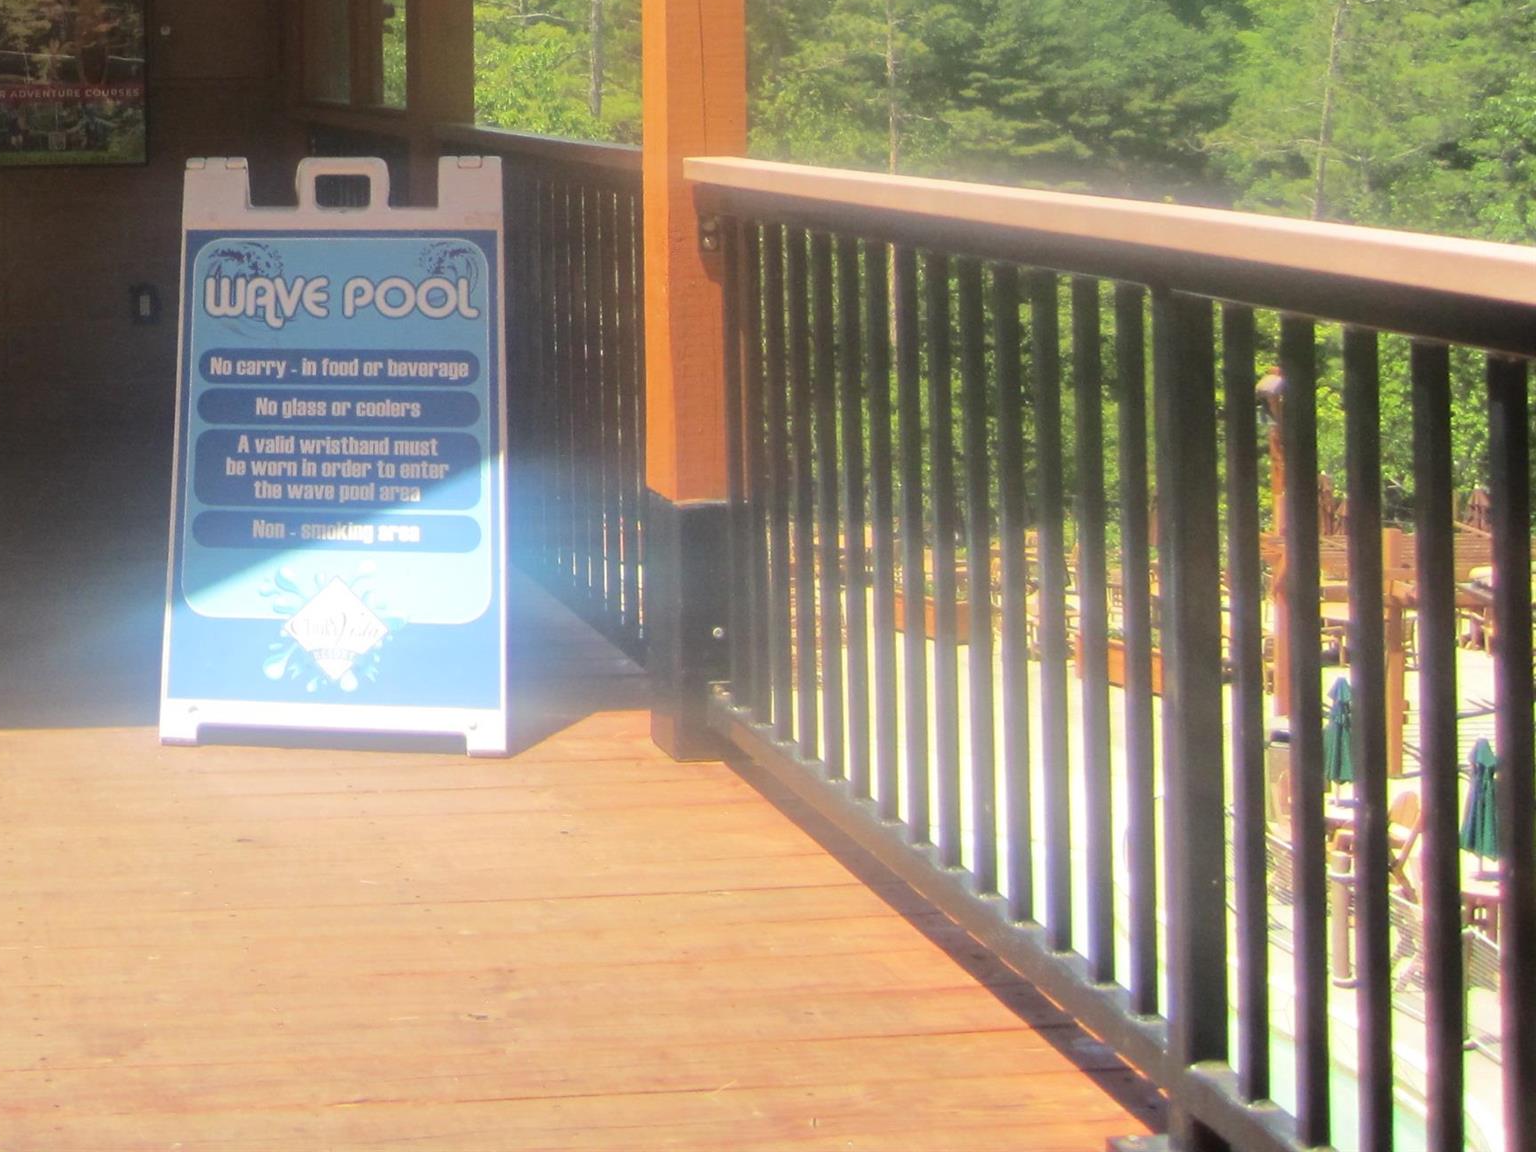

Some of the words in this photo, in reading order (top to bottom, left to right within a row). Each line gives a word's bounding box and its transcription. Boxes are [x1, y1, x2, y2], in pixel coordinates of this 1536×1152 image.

[10, 88, 80, 98] ADVENTURE
[204, 276, 330, 329] WAVE
[342, 276, 480, 320] POOL
[210, 357, 232, 375] No
[236, 359, 286, 379] carry
[302, 358, 316, 376] in
[322, 358, 359, 376] food
[363, 361, 383, 377] or
[387, 358, 469, 380] beverage
[256, 397, 277, 416] No
[282, 398, 326, 419] glass
[331, 401, 351, 416] or
[356, 399, 421, 418] coolers
[237, 435, 249, 453] A
[255, 435, 295, 454] valid
[300, 436, 389, 455] wristband
[394, 438, 438, 456] must
[226, 457, 246, 475] be
[251, 460, 297, 477] worn
[302, 459, 316, 477] in
[321, 458, 371, 478] order
[377, 460, 395, 478] to
[400, 461, 449, 479] enter
[254, 481, 281, 499] the
[288, 484, 334, 500] wave
[339, 483, 375, 503] pool
[380, 485, 421, 502] area
[253, 520, 285, 538] Non
[301, 522, 374, 543] smoking
[377, 524, 421, 542] area
